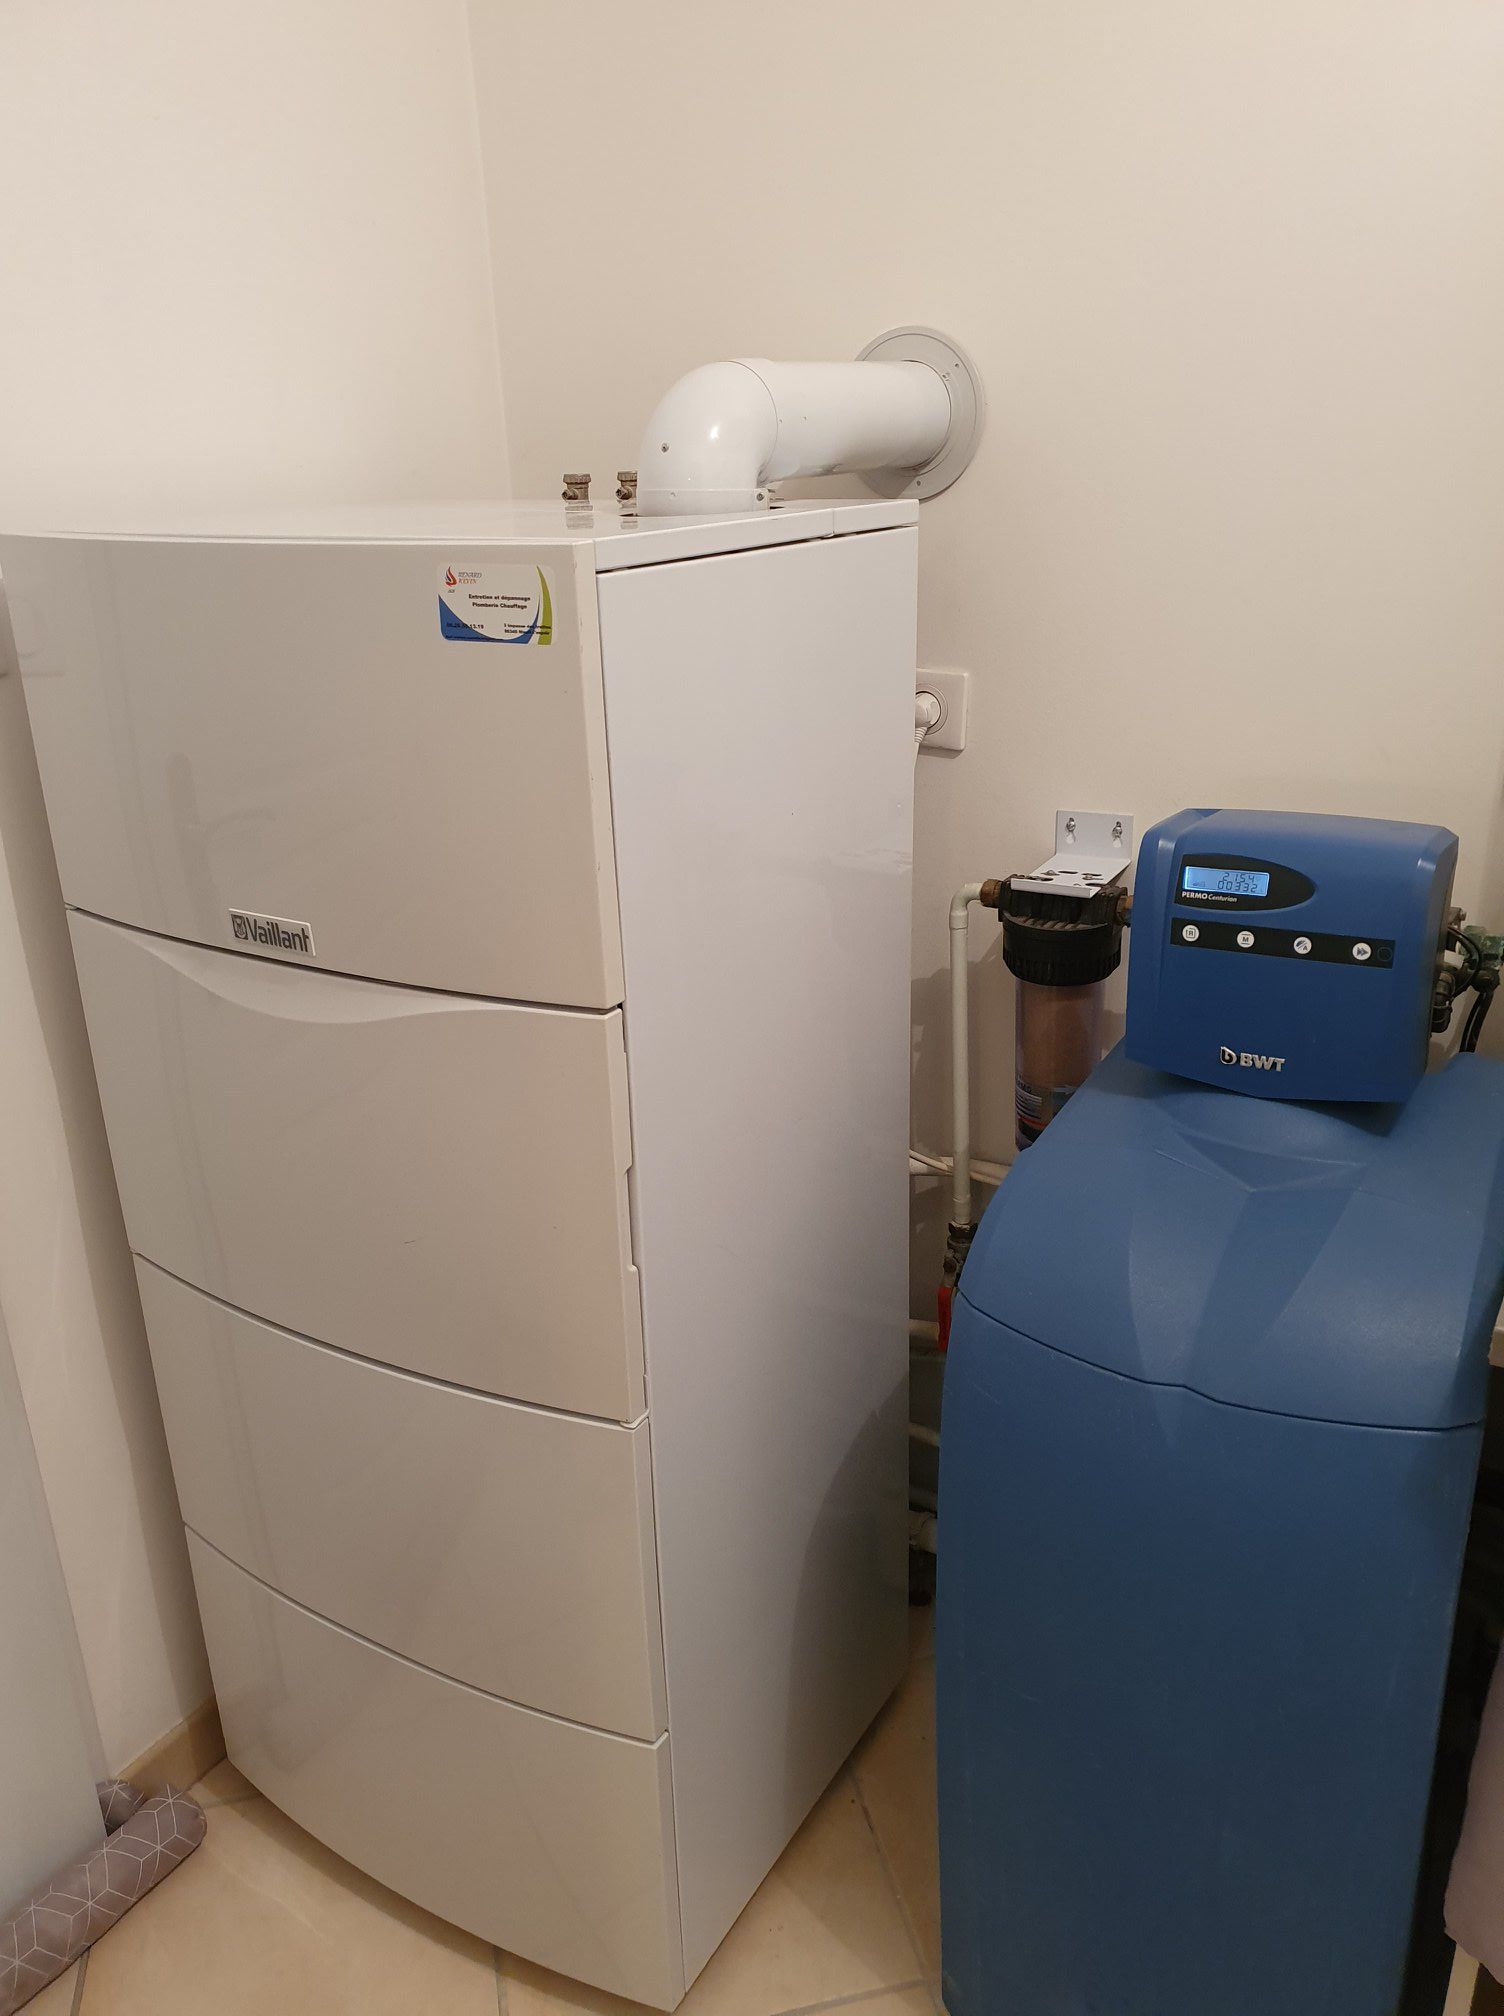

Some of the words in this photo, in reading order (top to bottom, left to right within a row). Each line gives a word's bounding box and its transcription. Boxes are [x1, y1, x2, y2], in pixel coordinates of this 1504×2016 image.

[1217, 880, 1258, 893] 00332
[1181, 891, 1208, 900] PERMO
[1208, 894, 1238, 903] Centurion
[245, 916, 310, 952] Vaillant
[1239, 1052, 1286, 1072] BWT
